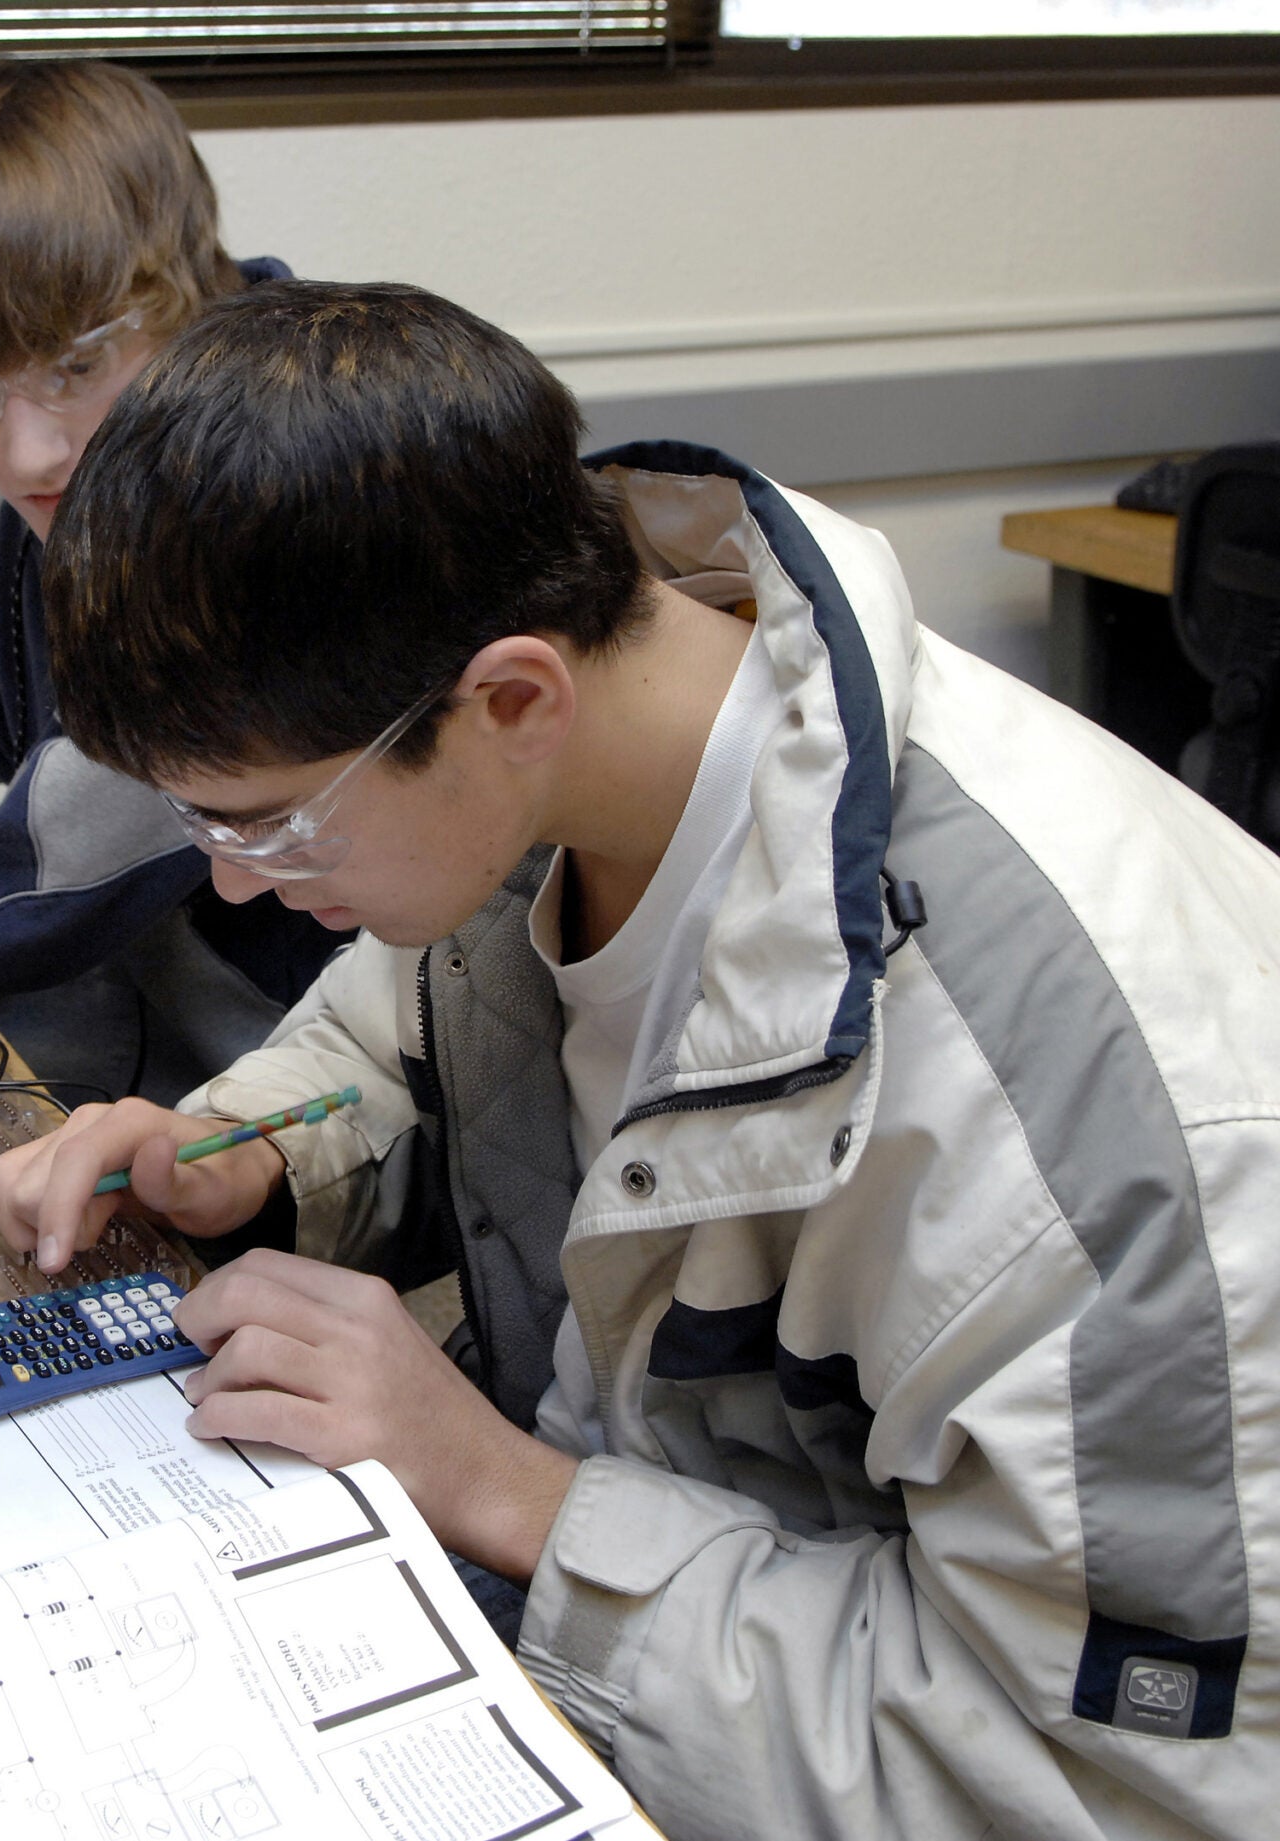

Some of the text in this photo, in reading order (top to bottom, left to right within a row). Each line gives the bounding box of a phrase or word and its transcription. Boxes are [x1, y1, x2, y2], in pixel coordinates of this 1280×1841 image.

[231, 1664, 260, 1700] FIGURE
[274, 1638, 323, 1713] PARTS NEEDED
[335, 1643, 363, 1680] Resistors
[353, 1776, 391, 1821] PURPOSE
